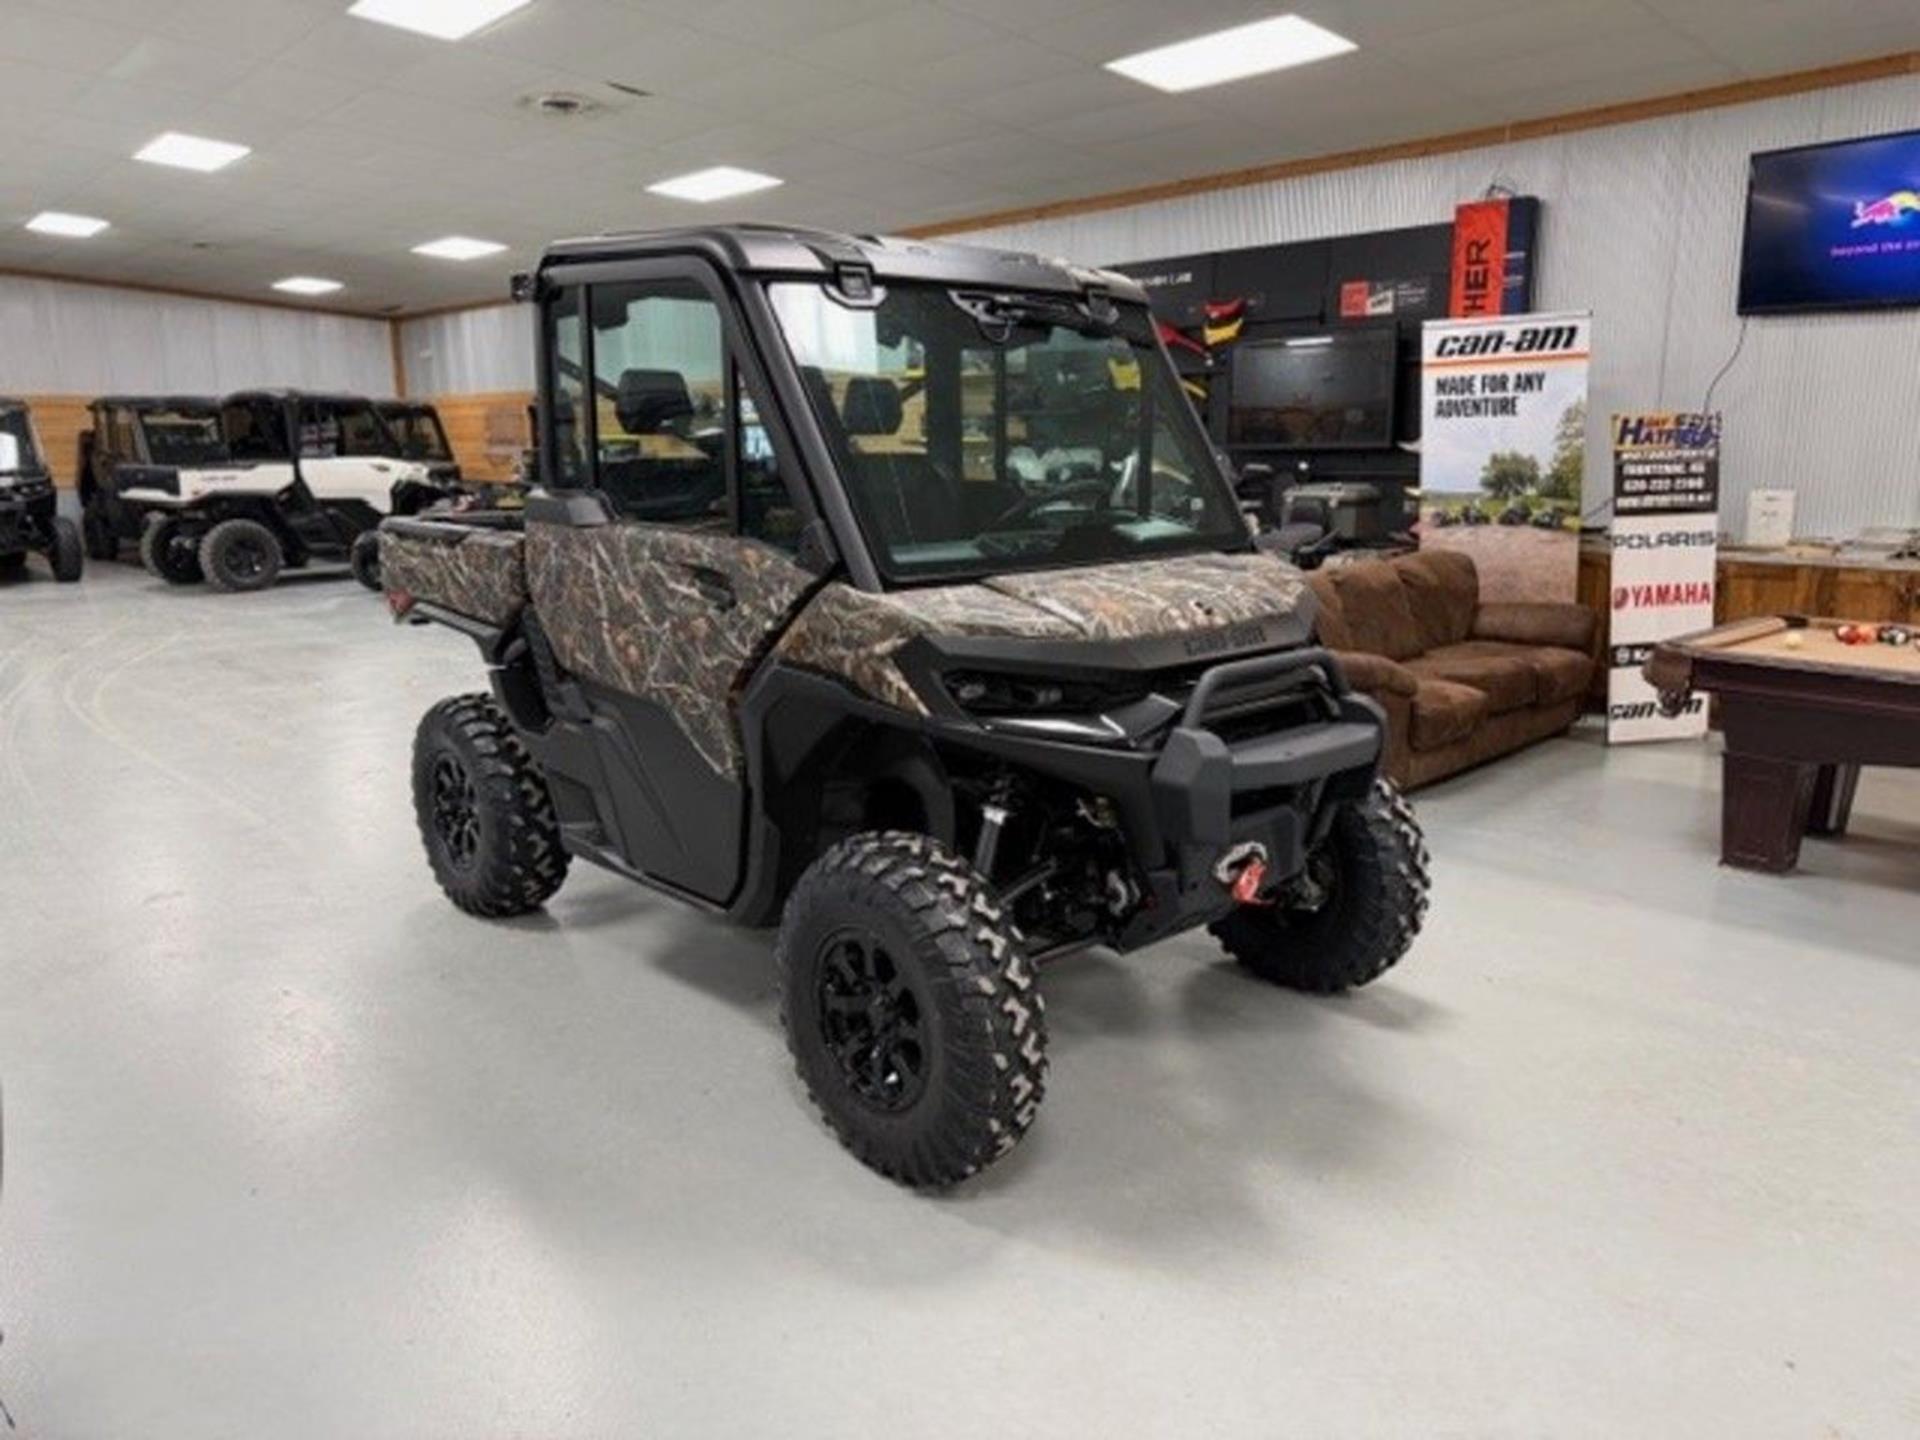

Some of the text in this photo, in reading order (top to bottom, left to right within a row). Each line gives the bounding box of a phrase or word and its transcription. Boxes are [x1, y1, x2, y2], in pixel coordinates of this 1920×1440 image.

[1462, 238, 1492, 318] HER
[1435, 326, 1578, 357] can-am
[1436, 371, 1546, 396] MADE FOR ANY
[1435, 397, 1519, 418] ADVENTURE
[1613, 531, 1714, 549] POLARIS
[1631, 582, 1710, 607] YAMAHA
